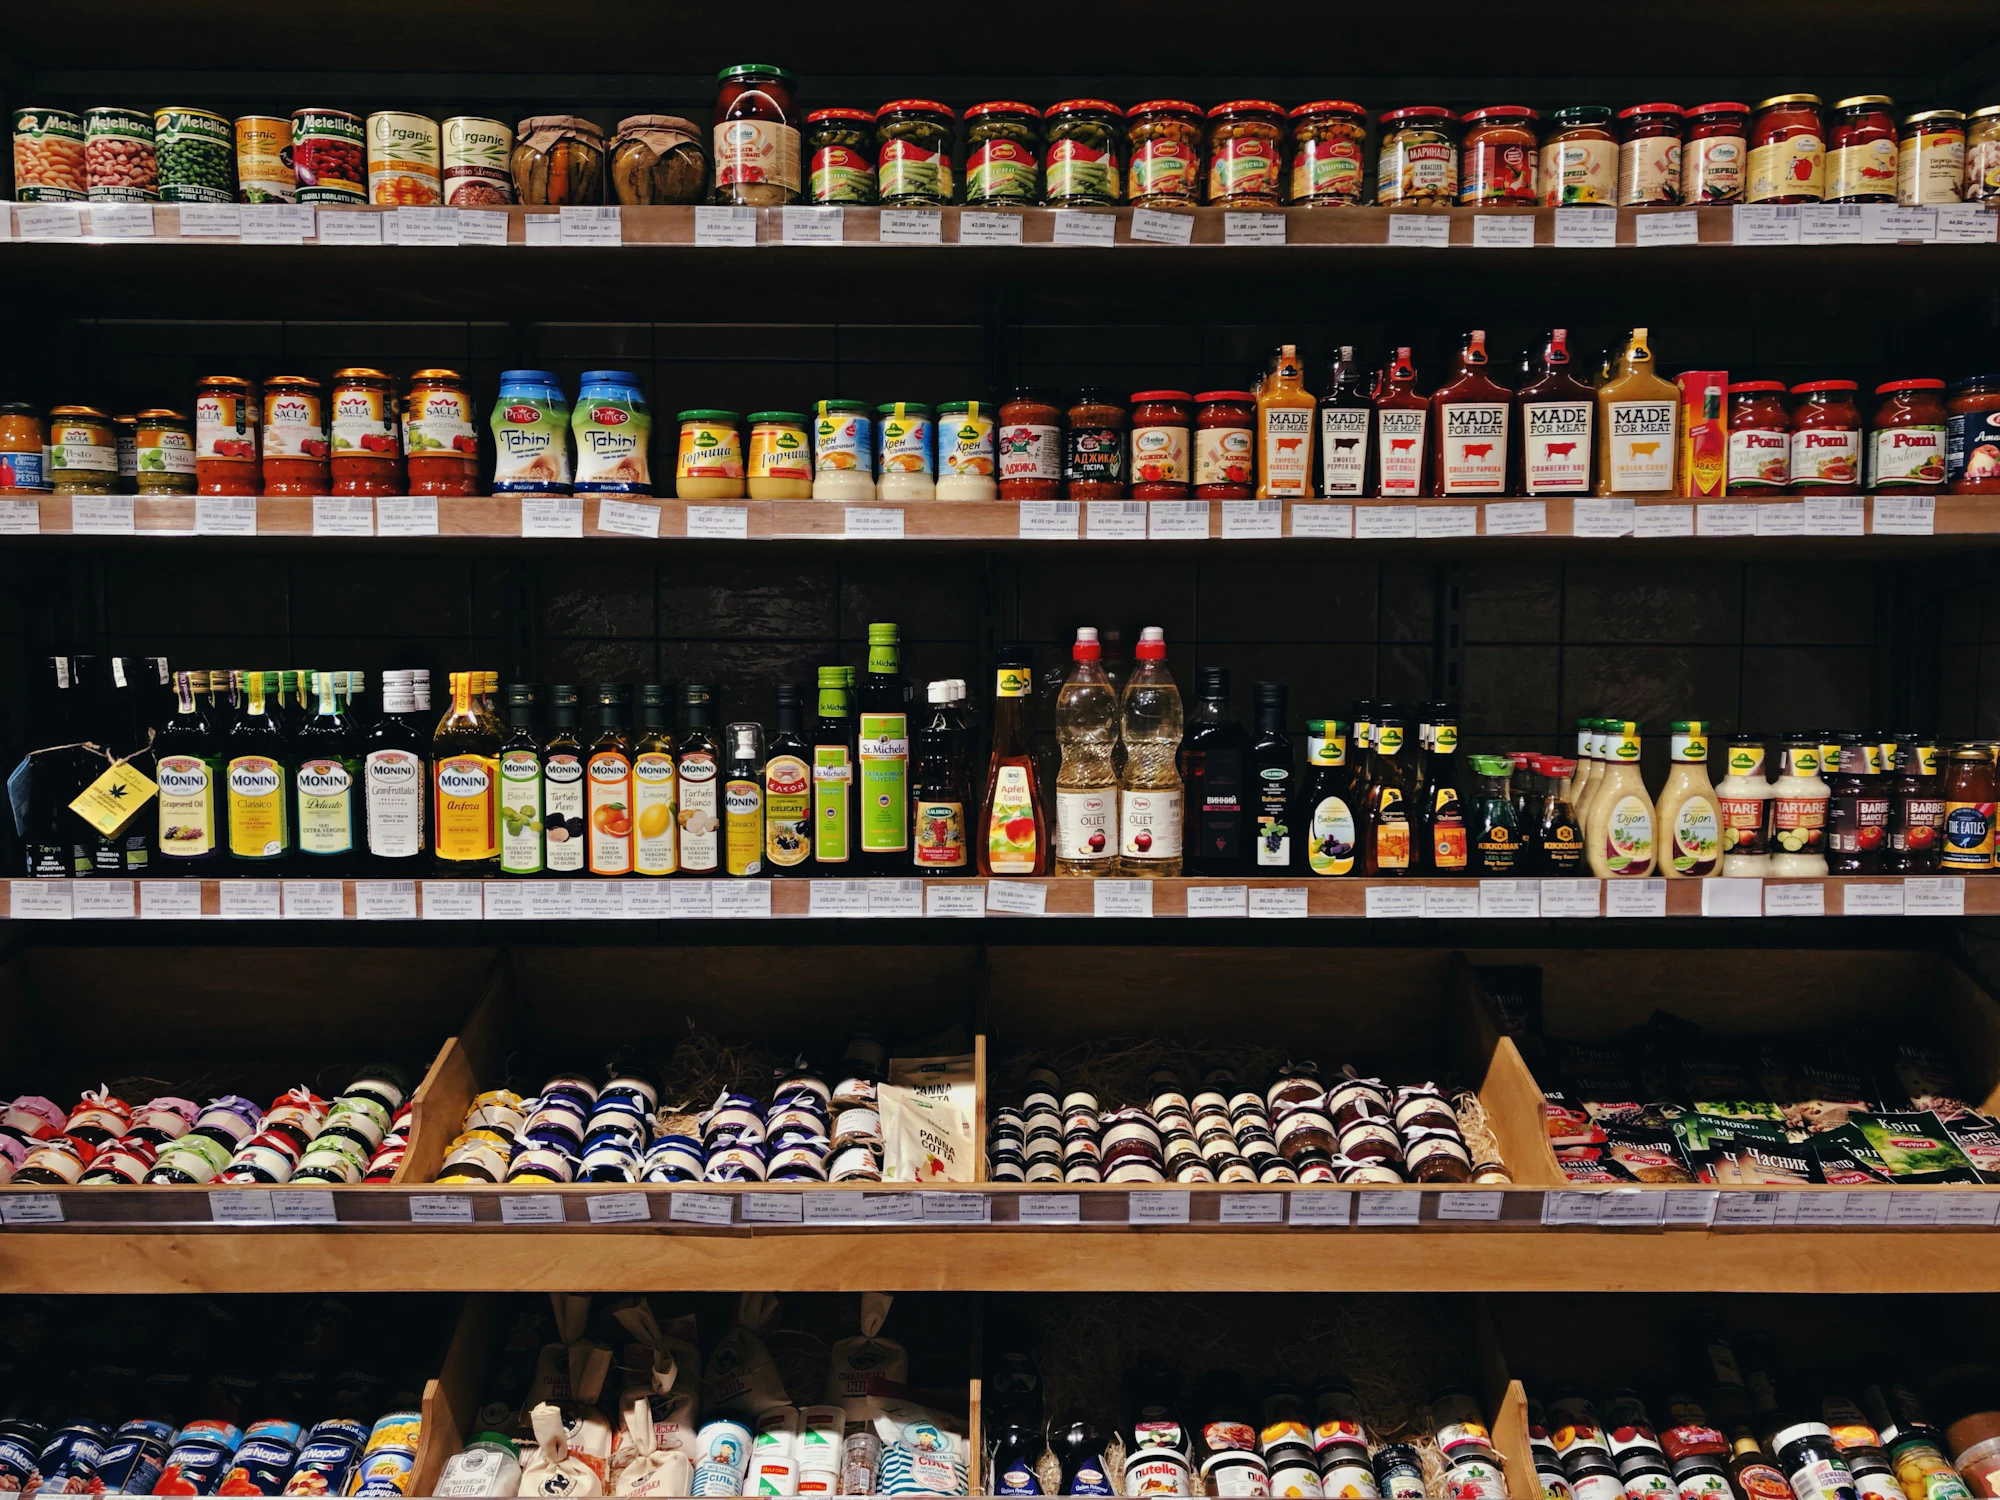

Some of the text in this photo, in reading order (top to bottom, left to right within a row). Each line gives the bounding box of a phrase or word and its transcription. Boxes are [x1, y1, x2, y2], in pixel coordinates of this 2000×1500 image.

[376, 116, 433, 143] Organic
[450, 122, 504, 147] Organic
[1410, 147, 1450, 160] МАРИНАДО
[505, 406, 540, 420] Prince
[591, 408, 628, 421] Prince
[1449, 411, 1503, 426] MADE
[1530, 408, 1586, 424] MADE
[1614, 408, 1671, 424] MADE
[1269, 413, 1309, 426] MADE
[1326, 413, 1366, 425] MADE
[1382, 414, 1422, 427] MADE
[1269, 424, 1309, 432] FOR MEAT
[1326, 424, 1366, 432] FOR MEAT
[1382, 425, 1422, 433] FOR MEAT
[1448, 426, 1504, 435] FOR MEAT
[1529, 424, 1588, 434] FOR MEAT
[1614, 424, 1672, 433] FOR MEAT
[499, 430, 551, 452] Tahini
[585, 429, 637, 452] Tahini
[818, 434, 837, 448] Хрен
[884, 438, 904, 451] Хрен
[1746, 433, 1784, 449] Pomì
[1805, 434, 1848, 449] Pomì
[1892, 433, 1937, 448] Pomì
[956, 440, 981, 454] Хрен
[66, 450, 92, 459] Pesto
[164, 451, 189, 461] Pesto
[681, 446, 732, 466] Горчица
[761, 449, 810, 468] Горчица
[1074, 453, 1115, 463] АДЖИКА
[1005, 462, 1037, 473] АДЖИКА
[1083, 463, 1105, 472] ГОСТРА
[1531, 464, 1569, 473] CRANBERRY
[16, 475, 40, 483] PESTO
[373, 766, 412, 776] MONINI
[504, 764, 537, 773] MONINI
[548, 765, 581, 774] MONINI
[592, 765, 627, 775] MONINI
[638, 766, 671, 775] MONINI
[681, 765, 715, 774] MONINI
[160, 775, 204, 786] MONINI
[229, 775, 277, 787] MONINI
[299, 775, 348, 787] MONINI
[441, 775, 486, 787] MONINI
[371, 786, 415, 796] GranFruttato
[642, 790, 668, 800] Limone
[682, 789, 714, 800] Tartufo
[1001, 784, 1025, 796] Apfel
[507, 791, 535, 802] Basilico
[550, 792, 579, 802] Tartufo
[1003, 793, 1024, 805] Essig
[1206, 796, 1237, 805] ВИННИЙ
[162, 800, 204, 811] Grapeseed Oil
[237, 800, 273, 809] Classico
[305, 800, 343, 811] Delicato
[446, 800, 480, 811] Anfora
[555, 801, 575, 812] Nero
[685, 798, 712, 808] Bianco
[1776, 802, 1826, 814] TARTARE
[770, 805, 804, 813] DELICATE
[1080, 815, 1107, 826] ОЦЕТ
[1128, 814, 1154, 825] ОЦЕТ
[1317, 814, 1349, 824] Balsamic
[1616, 813, 1646, 826] Dijon
[1682, 813, 1712, 825] Dijon
[1861, 813, 1883, 821] SAUCE
[1910, 813, 1934, 821] SAUCE
[1949, 820, 1987, 836] THE EATLES
[1876, 1118, 1922, 1134] Кріп
[919, 1129, 956, 1157] PANNA
[1608, 1140, 1671, 1155] Коріандр
[921, 1139, 954, 1164] COTTA
[1745, 1146, 1810, 1172] Часник
[1135, 1463, 1177, 1479] nutella
[709, 1474, 733, 1486] СІЛЬ
[452, 1484, 475, 1494] СІЛЬ
